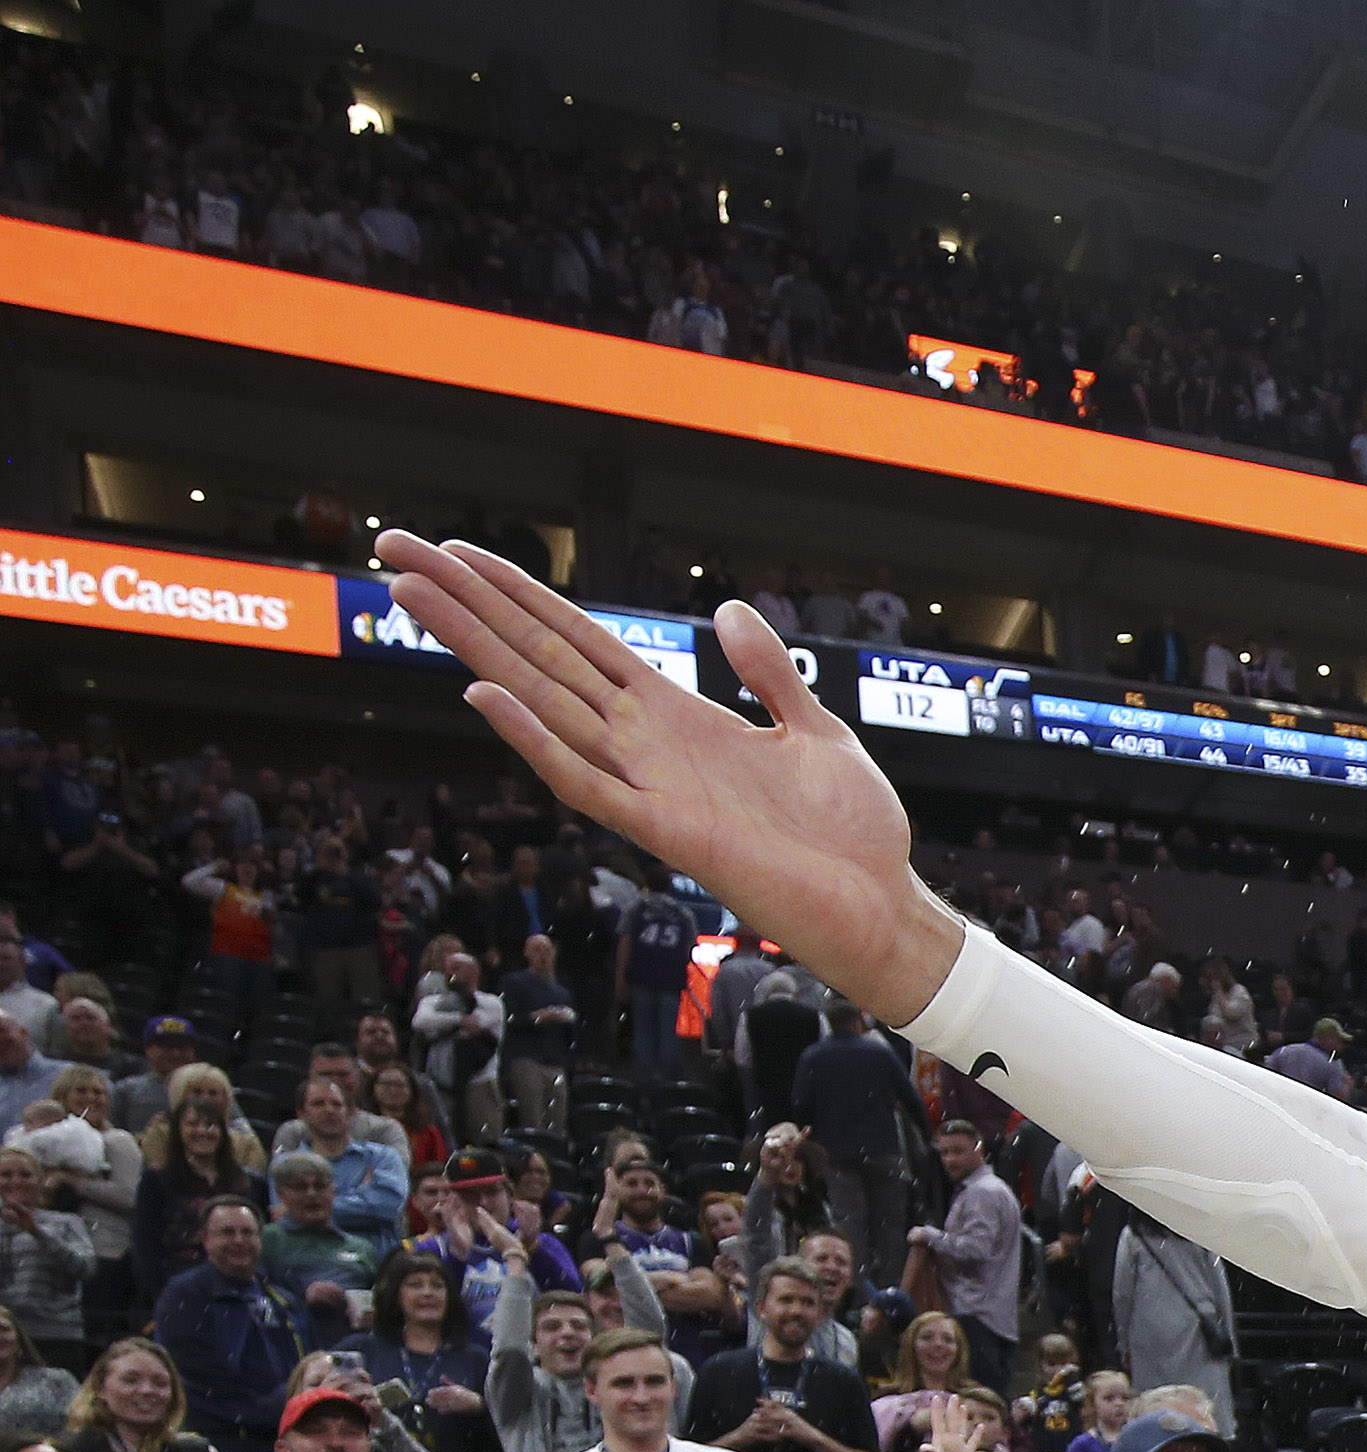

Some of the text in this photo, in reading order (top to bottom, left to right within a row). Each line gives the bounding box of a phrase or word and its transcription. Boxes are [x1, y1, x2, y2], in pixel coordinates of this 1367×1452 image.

[0, 552, 97, 605] ittle
[100, 565, 289, 630] Caesars
[871, 656, 951, 687] UTA
[892, 690, 935, 720] 112
[1039, 701, 1087, 717] DAL
[1200, 721, 1226, 739] 43
[1041, 725, 1091, 746] UTA
[1110, 734, 1166, 756] 40/91
[1200, 746, 1228, 765] 44
[1262, 754, 1311, 776] 15/43
